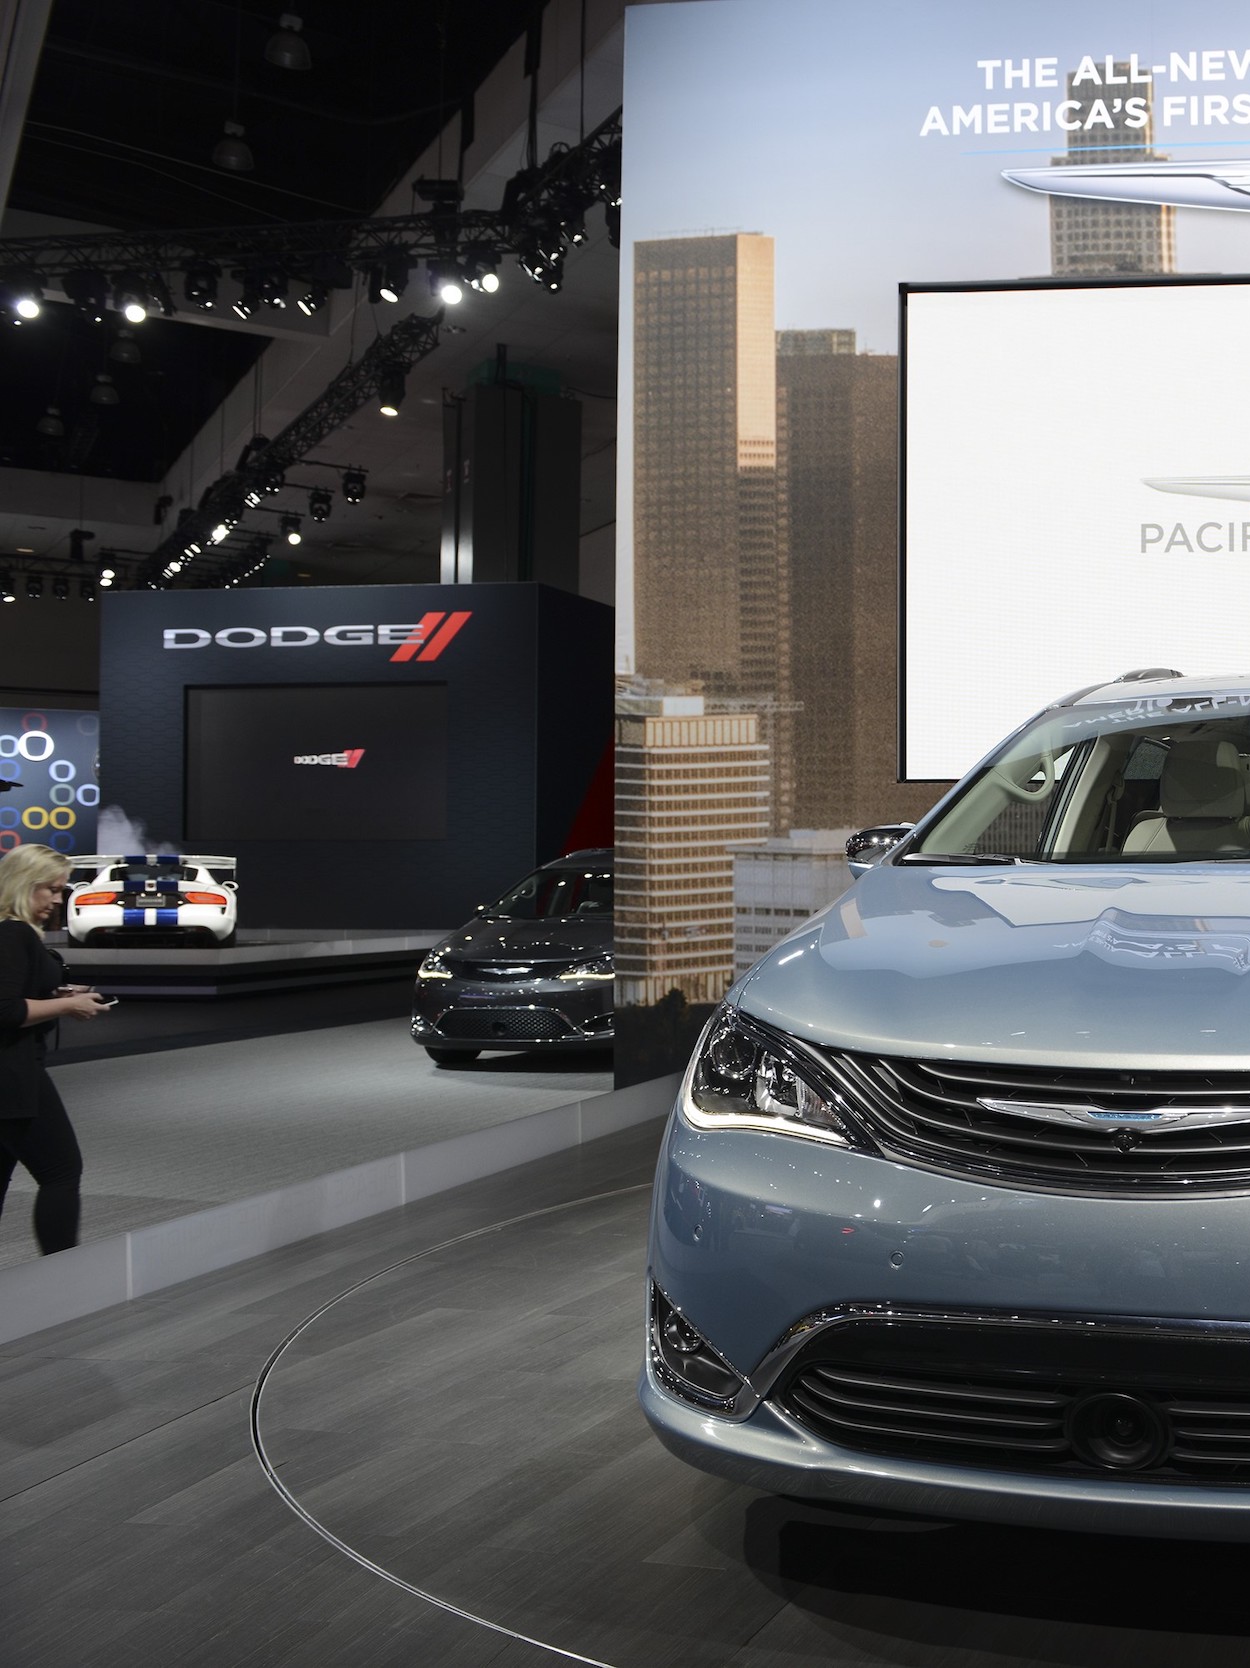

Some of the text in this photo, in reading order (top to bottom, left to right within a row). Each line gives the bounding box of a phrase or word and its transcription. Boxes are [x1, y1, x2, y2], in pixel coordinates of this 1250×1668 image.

[976, 57, 1058, 90] THE
[919, 97, 1147, 137] AMERICA'S
[163, 624, 424, 649] DODGE
[294, 753, 348, 765] DODGE
